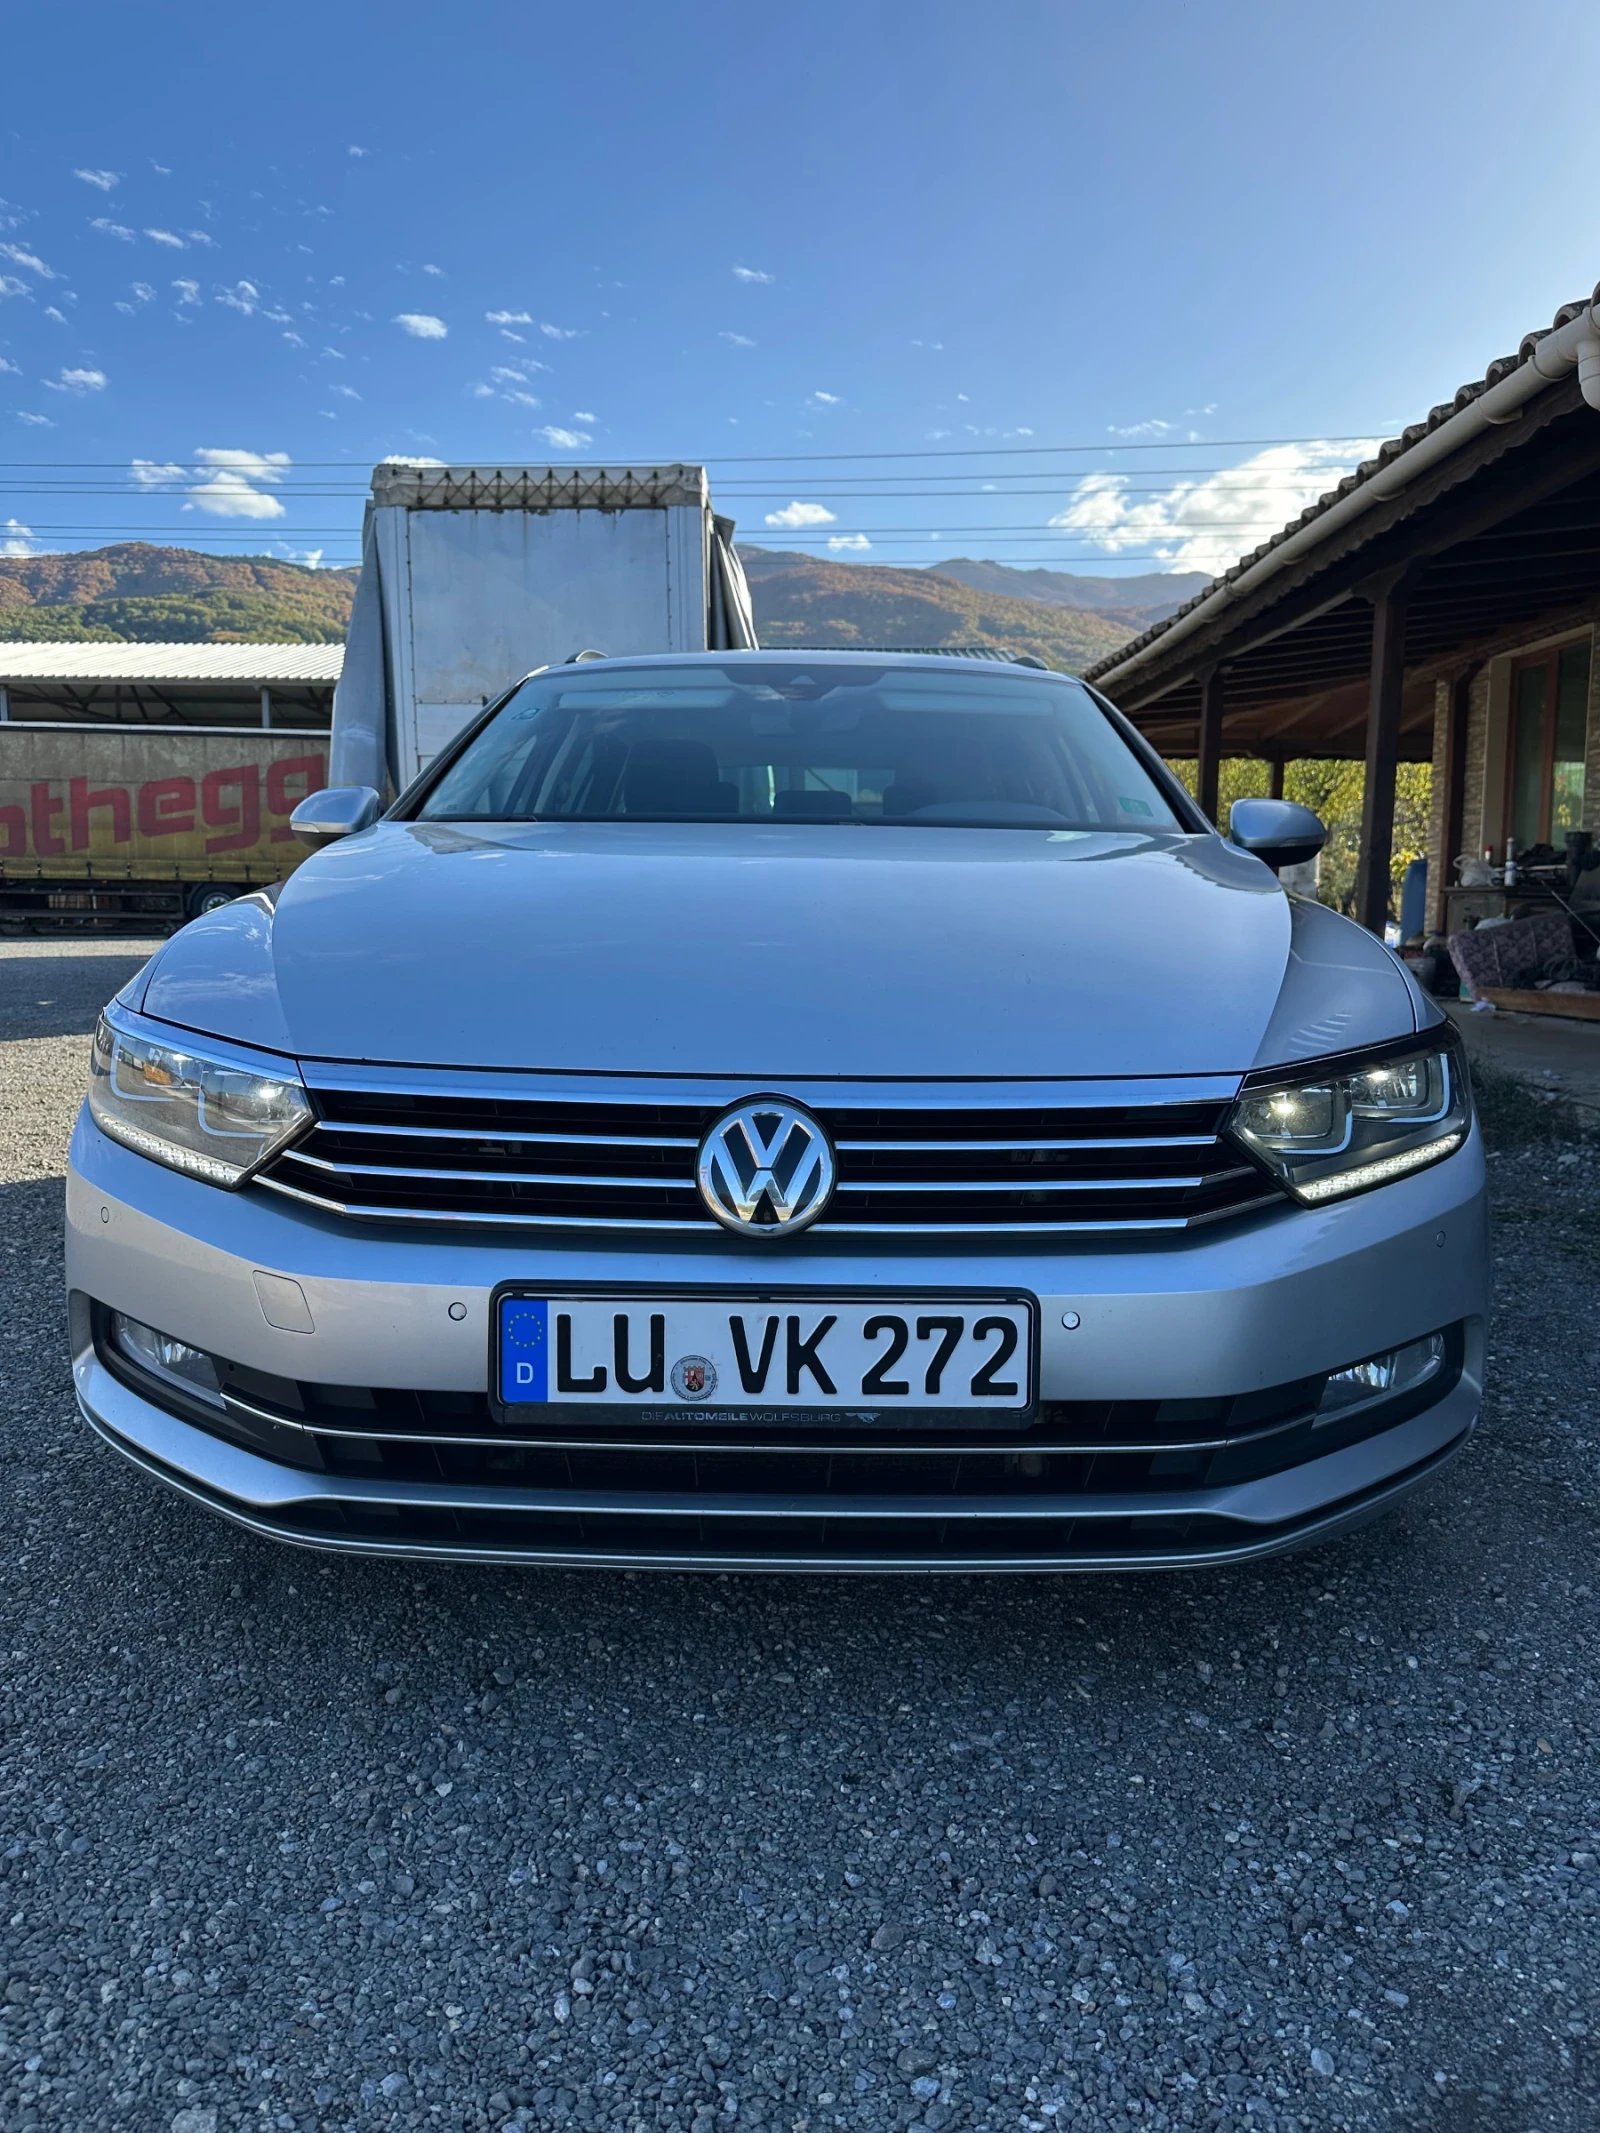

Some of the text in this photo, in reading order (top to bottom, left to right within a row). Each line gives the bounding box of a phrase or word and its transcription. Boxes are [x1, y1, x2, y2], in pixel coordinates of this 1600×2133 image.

[517, 1362, 533, 1384] D
[557, 1314, 664, 1393] LU
[729, 1316, 837, 1395] VK
[862, 1316, 1018, 1396] 272
